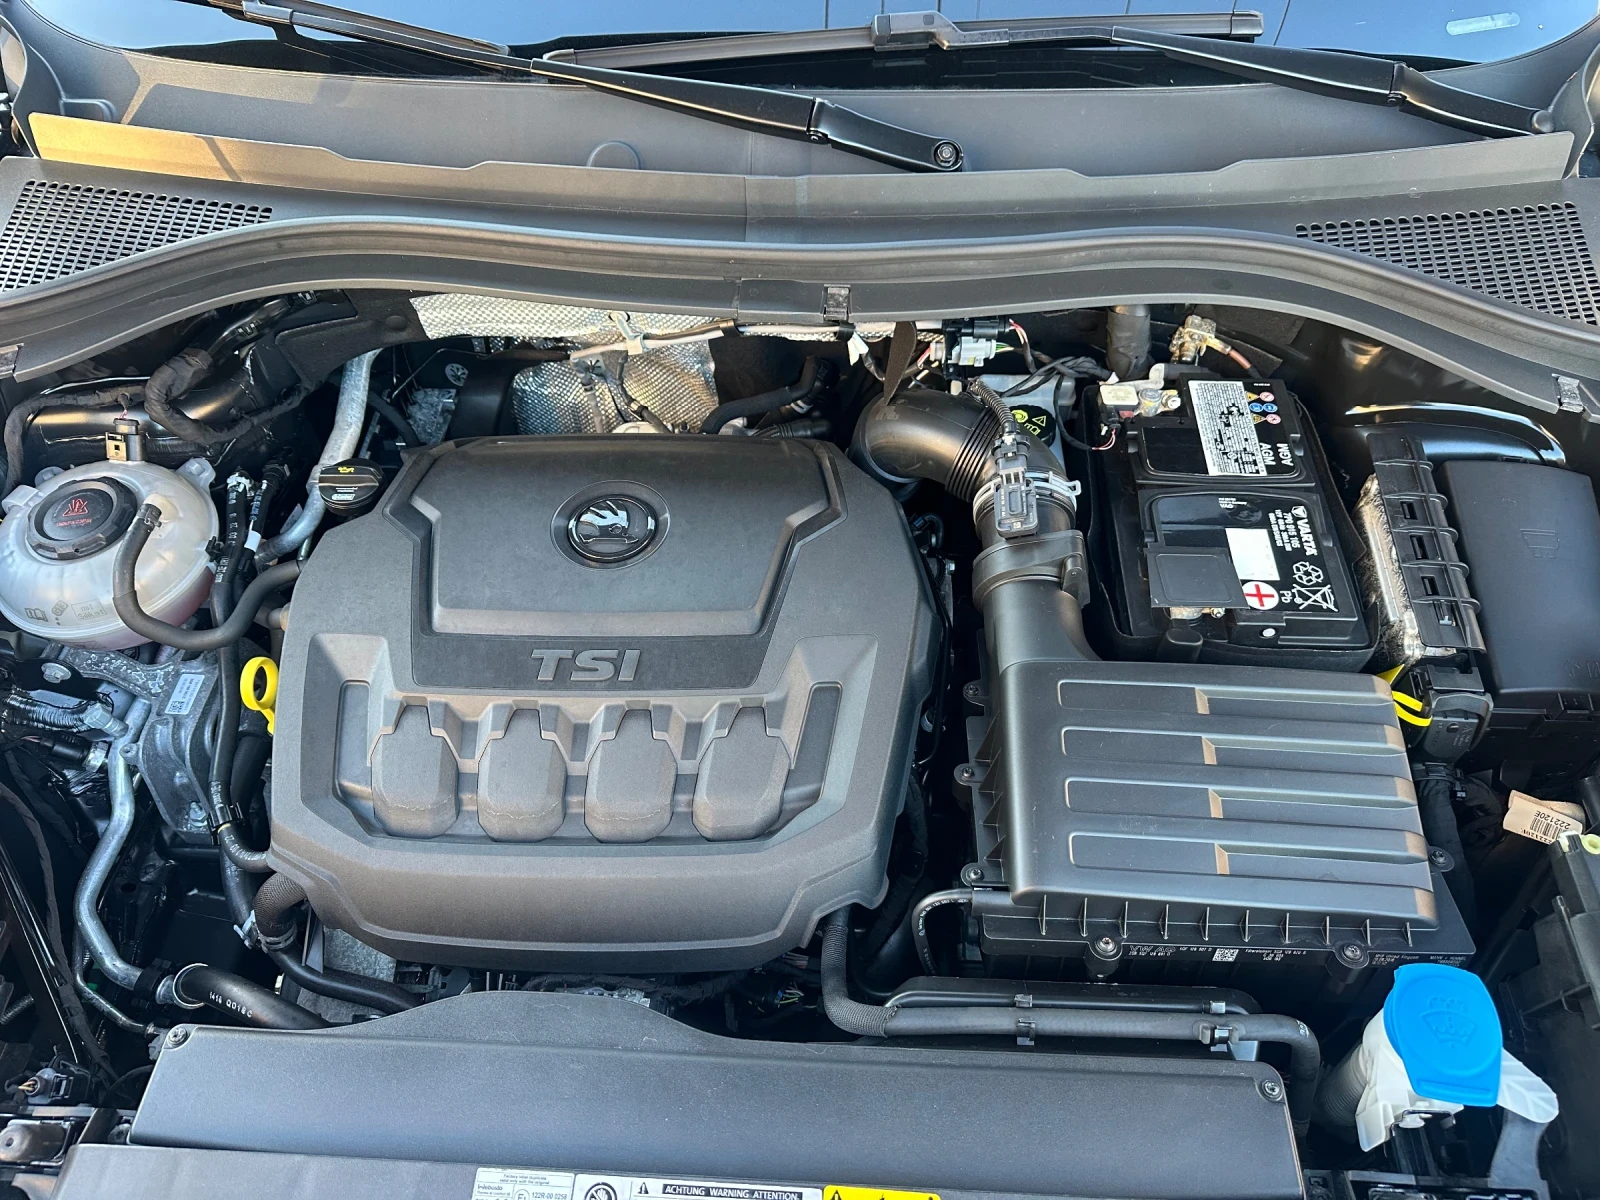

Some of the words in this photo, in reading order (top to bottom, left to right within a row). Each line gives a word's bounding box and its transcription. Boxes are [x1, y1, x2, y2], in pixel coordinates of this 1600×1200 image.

[1260, 442, 1276, 466] AGM
[1276, 443, 1294, 467] AGM
[1286, 524, 1297, 536] 915
[1289, 536, 1301, 548] 105
[1296, 518, 1318, 556] VARTA
[1279, 590, 1293, 603] Pb
[78, 609, 106, 620] Silikat
[531, 649, 641, 682] TSI
[1534, 810, 1571, 830] 222120E
[531, 1191, 554, 1199] 122R-00
[664, 1185, 705, 1196] ACHTUNG
[709, 1187, 749, 1198] WARNING
